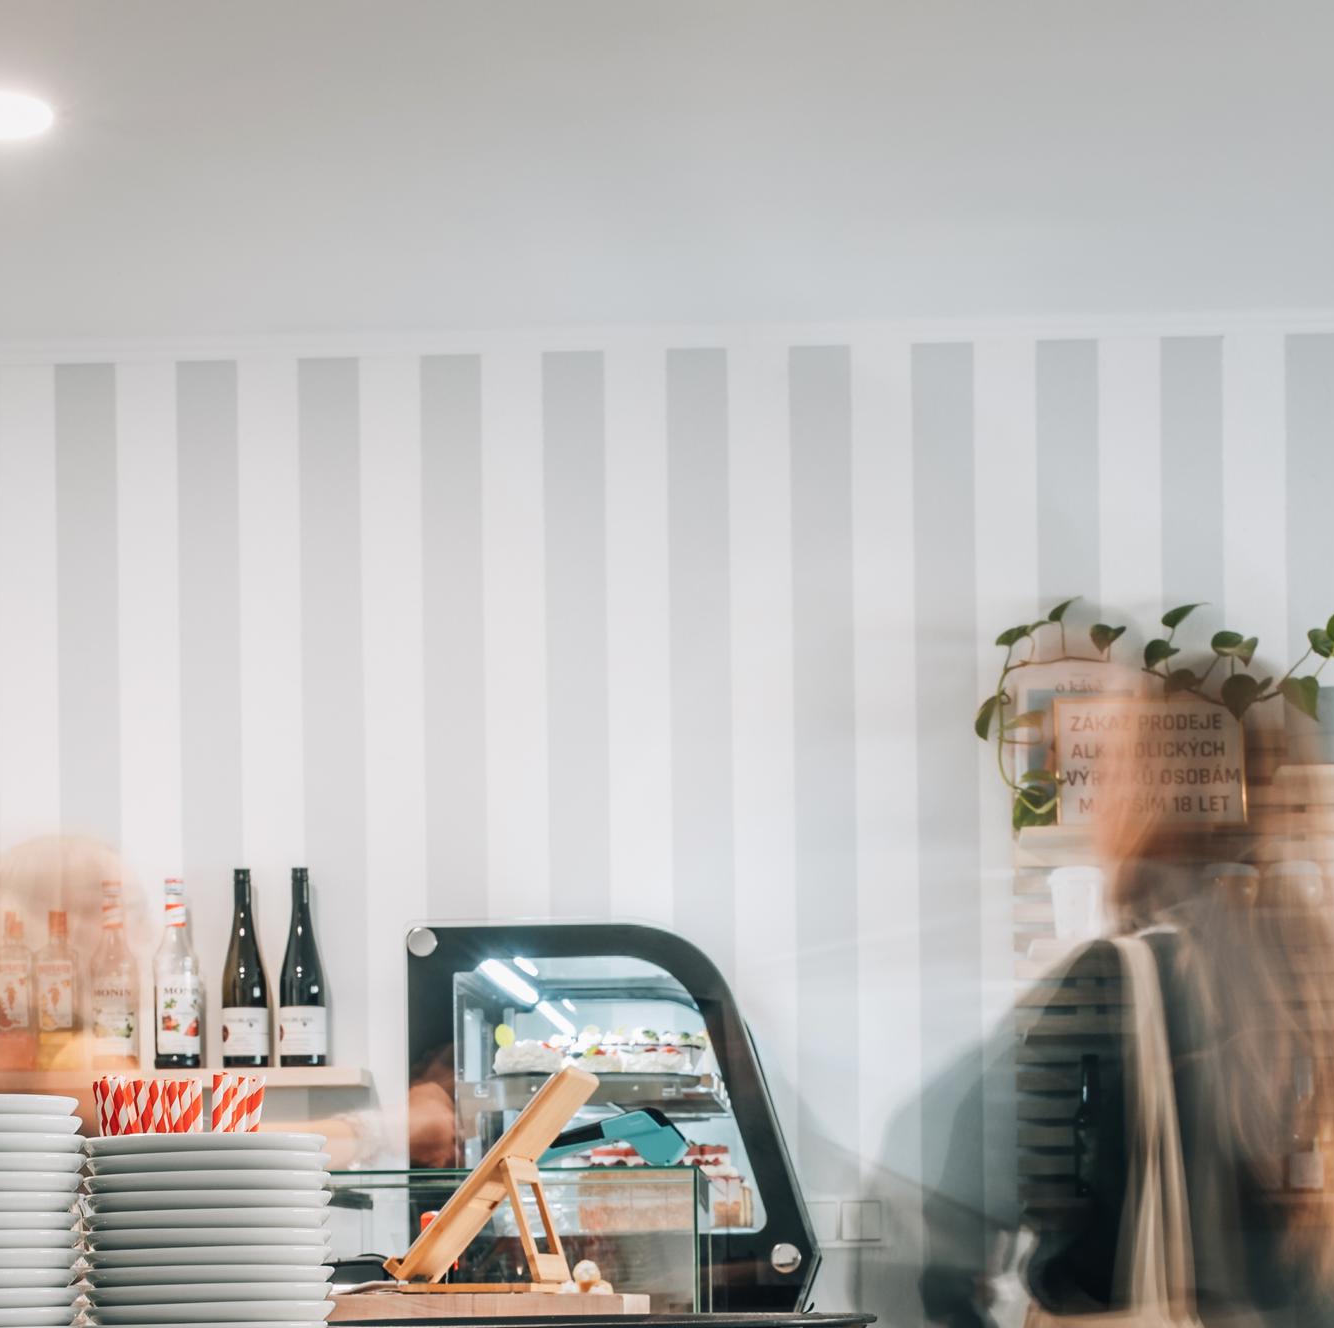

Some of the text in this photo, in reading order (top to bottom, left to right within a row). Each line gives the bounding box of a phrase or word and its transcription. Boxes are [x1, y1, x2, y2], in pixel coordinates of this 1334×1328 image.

[1070, 711, 1223, 732] ZÁKAZ PRODEJE
[1071, 737, 1225, 760] ALKOLICKÝCH
[1066, 763, 1242, 787] VÝRKŮ OSOBÁM
[1174, 796, 1192, 812] 18
[1199, 795, 1231, 812] LET
